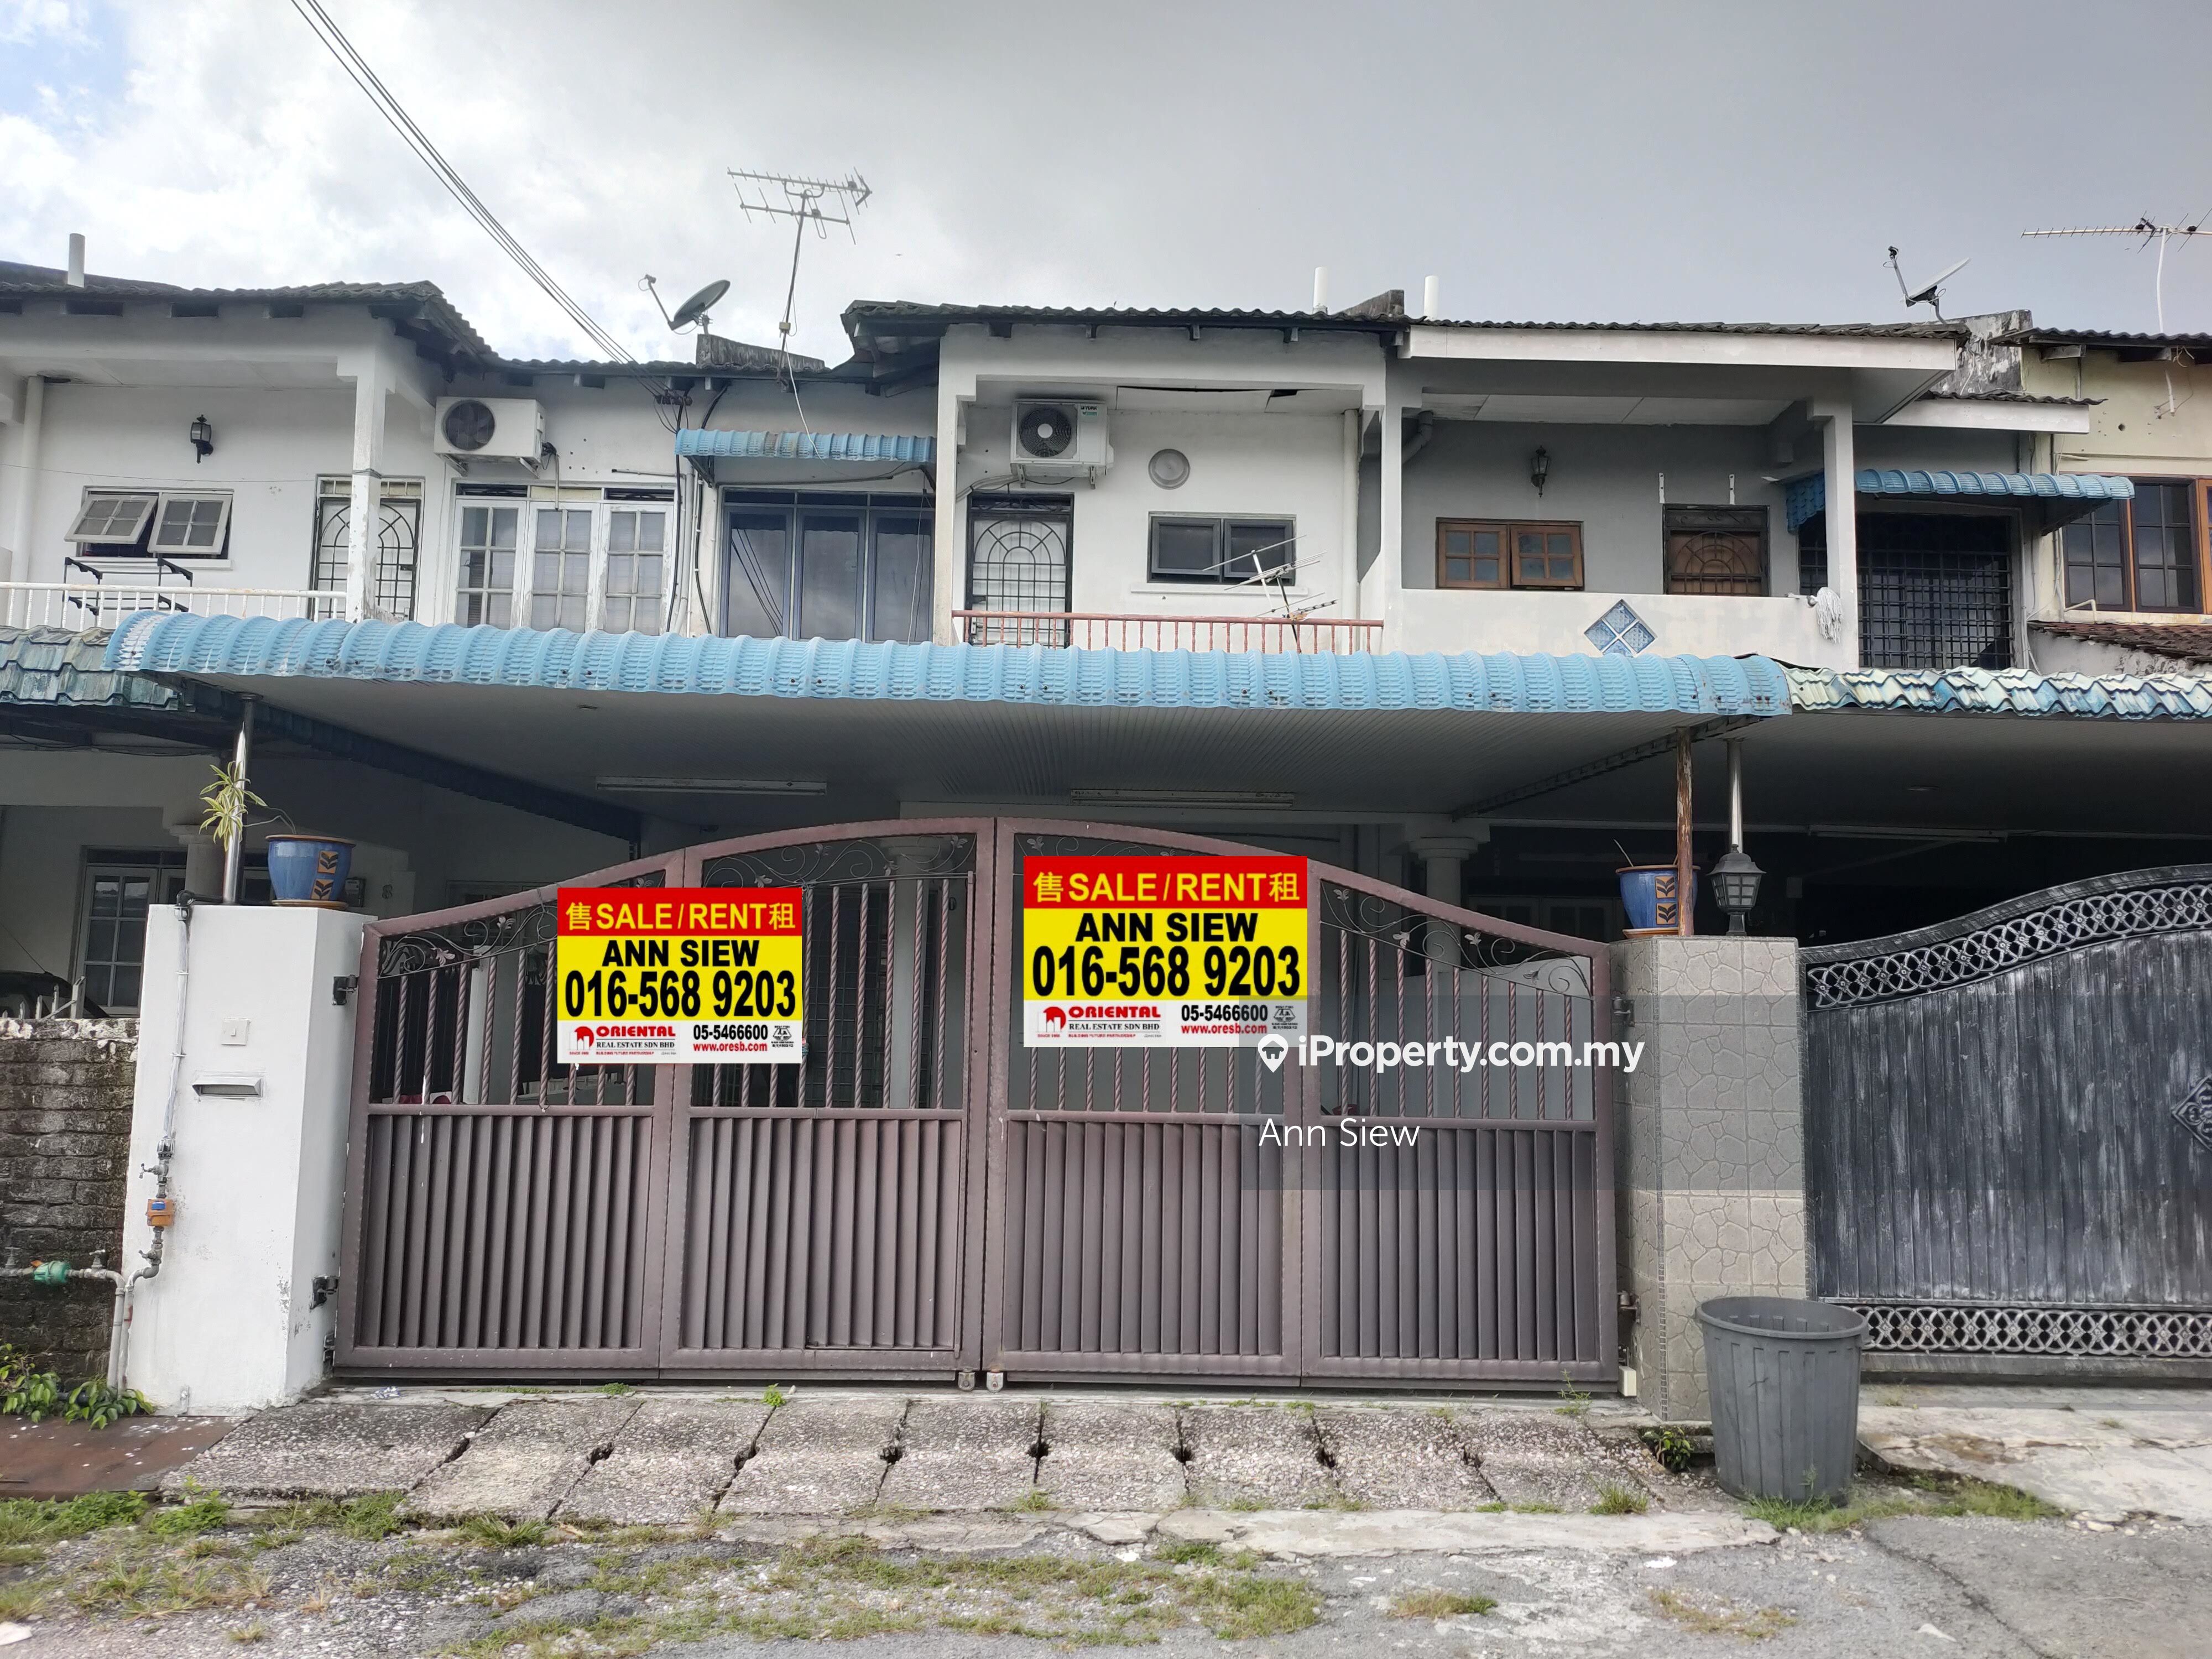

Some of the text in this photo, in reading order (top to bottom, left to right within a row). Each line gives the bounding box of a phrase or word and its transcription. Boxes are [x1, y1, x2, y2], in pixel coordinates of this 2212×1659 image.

[1075, 912, 1258, 942] ANN SIEW
[602, 940, 760, 967] ANN SIEW
[1032, 946, 1300, 997] 016-568 9203
[565, 970, 796, 1017] 016-568 9203
[1068, 1006, 1161, 1018] ORIENTAL
[1181, 1005, 1269, 1021] 05-5466600
[596, 1026, 676, 1037] ORIENTAL
[693, 1024, 768, 1040] 05-5466600
[1181, 1024, 1267, 1034] www.oresb.com
[693, 1042, 768, 1052] www.oresb.com
